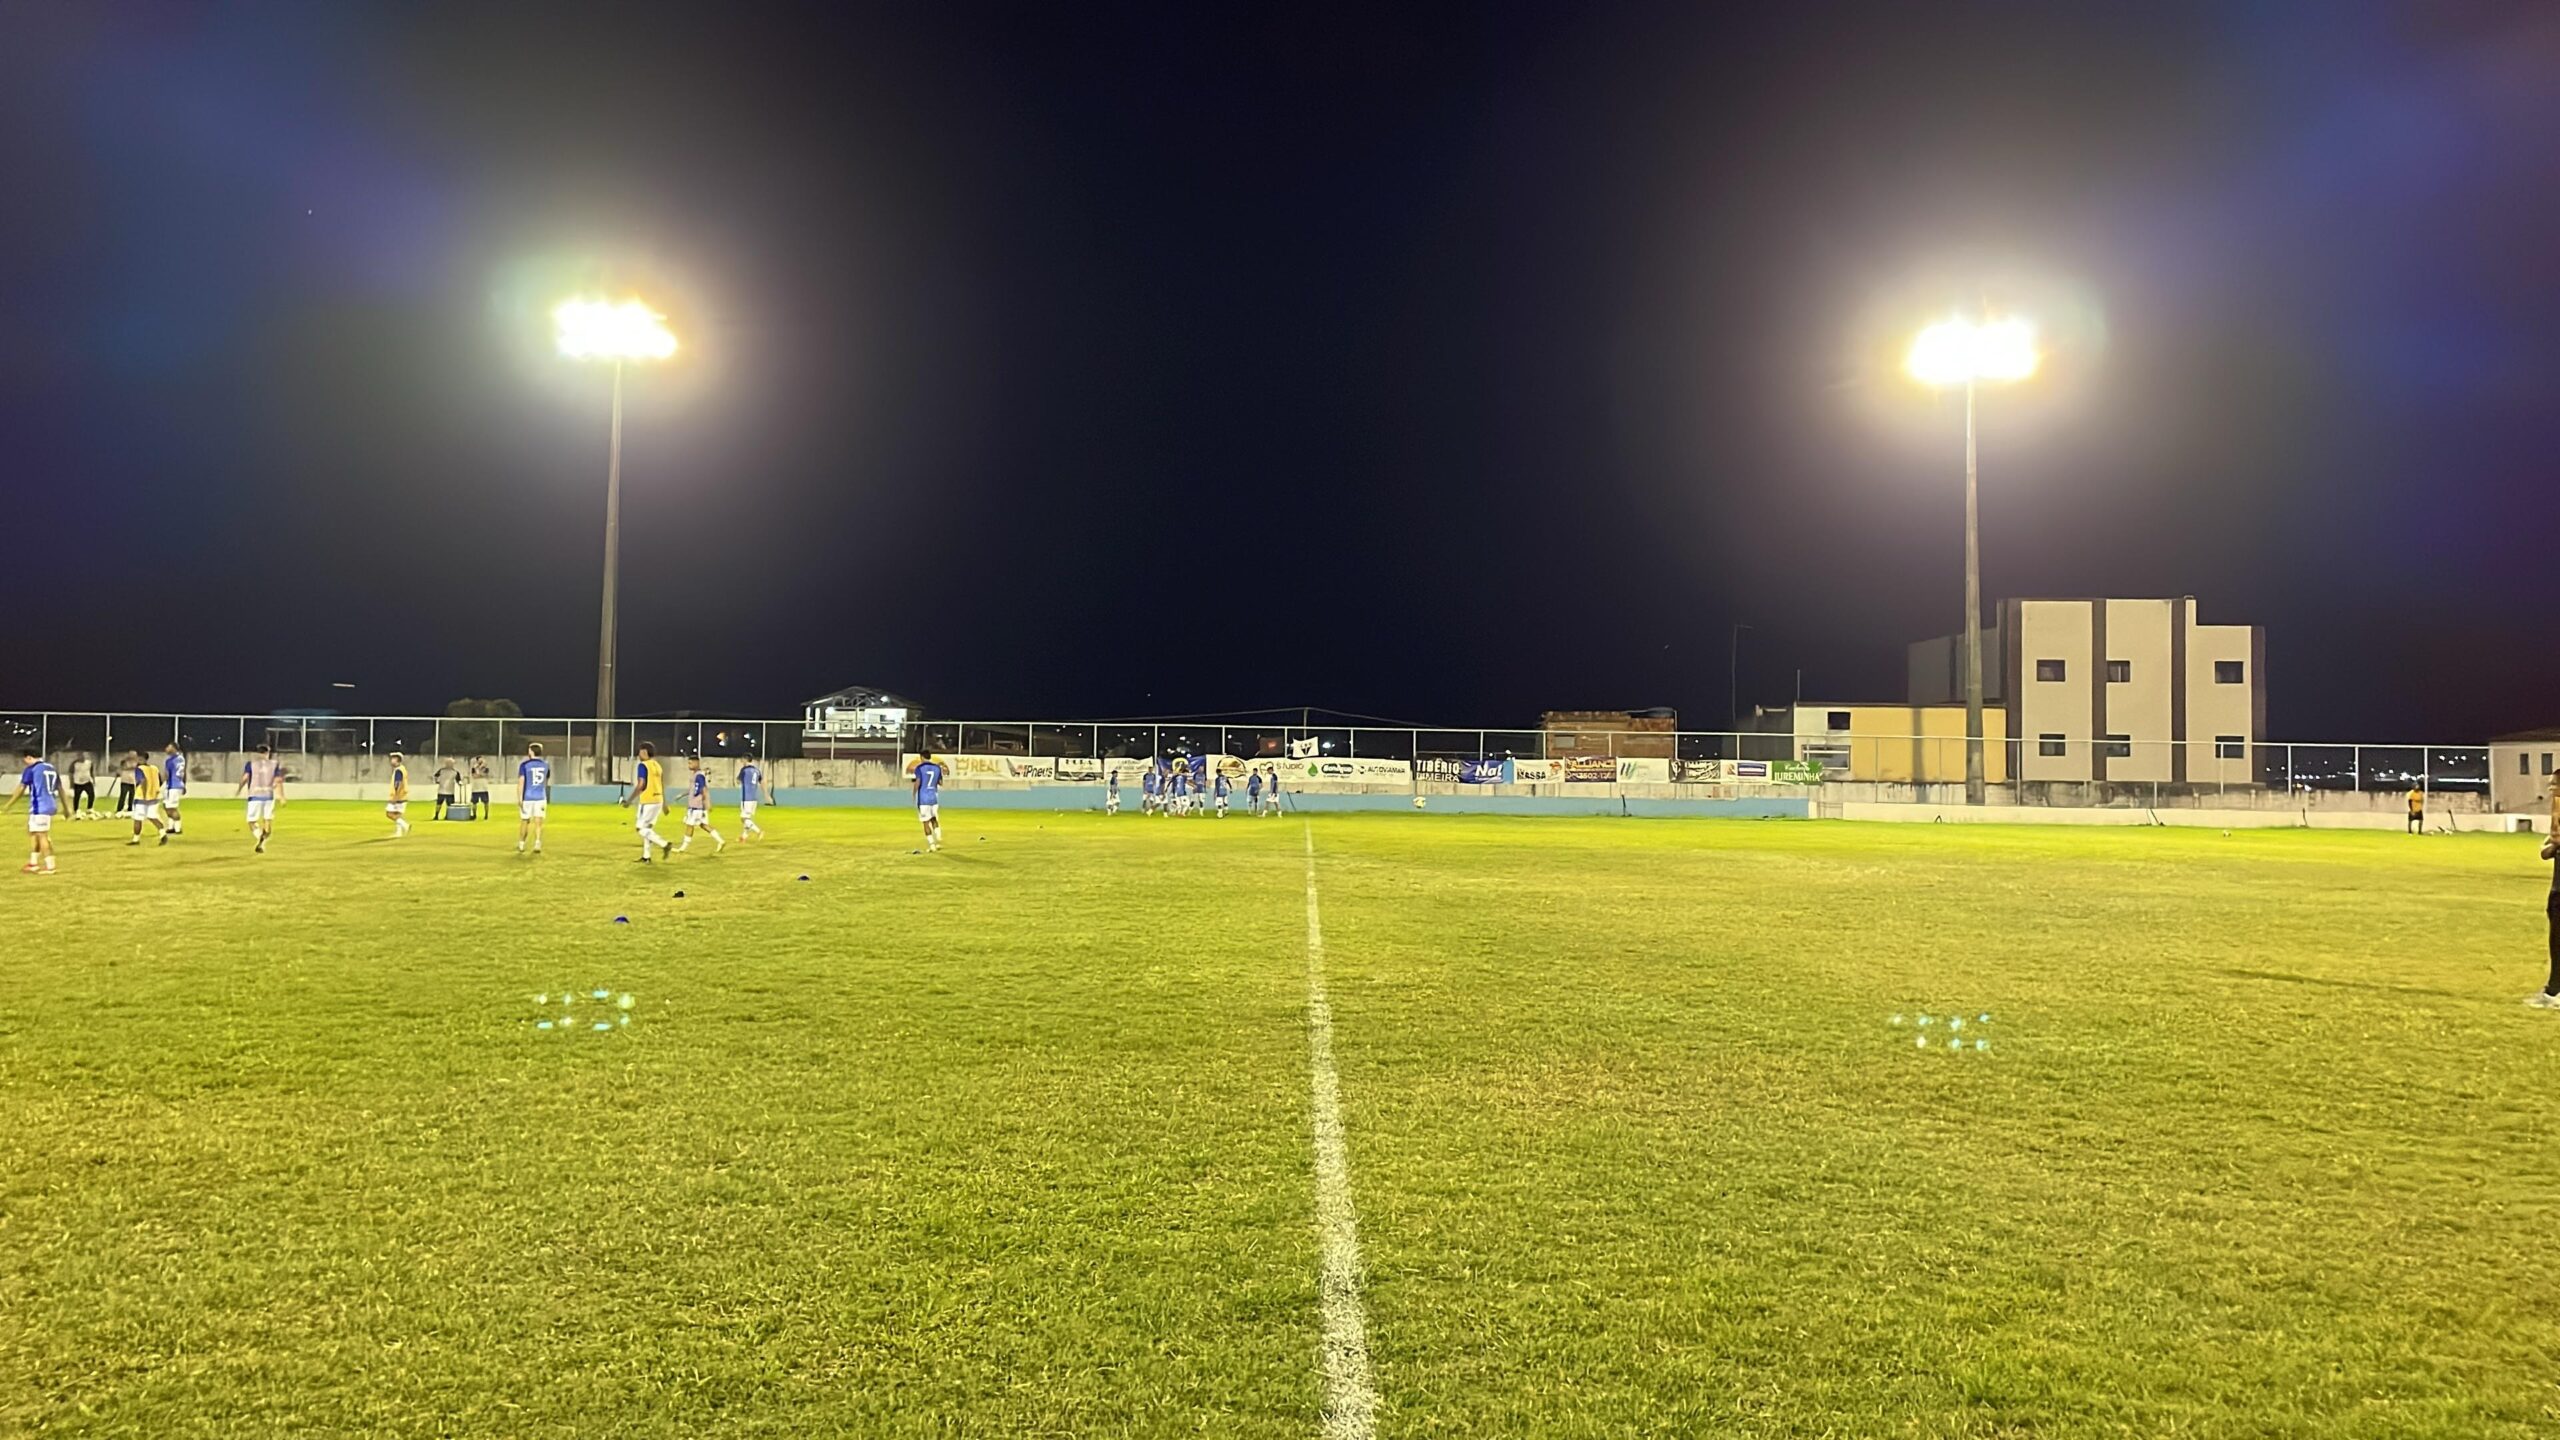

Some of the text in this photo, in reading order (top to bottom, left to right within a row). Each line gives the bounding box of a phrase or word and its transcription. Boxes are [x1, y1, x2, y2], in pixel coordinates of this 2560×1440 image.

[1416, 757, 1460, 775] TIBÉRIO
[43, 770, 57, 795] 17
[530, 767, 546, 786] 15
[926, 770, 935, 788] 7
